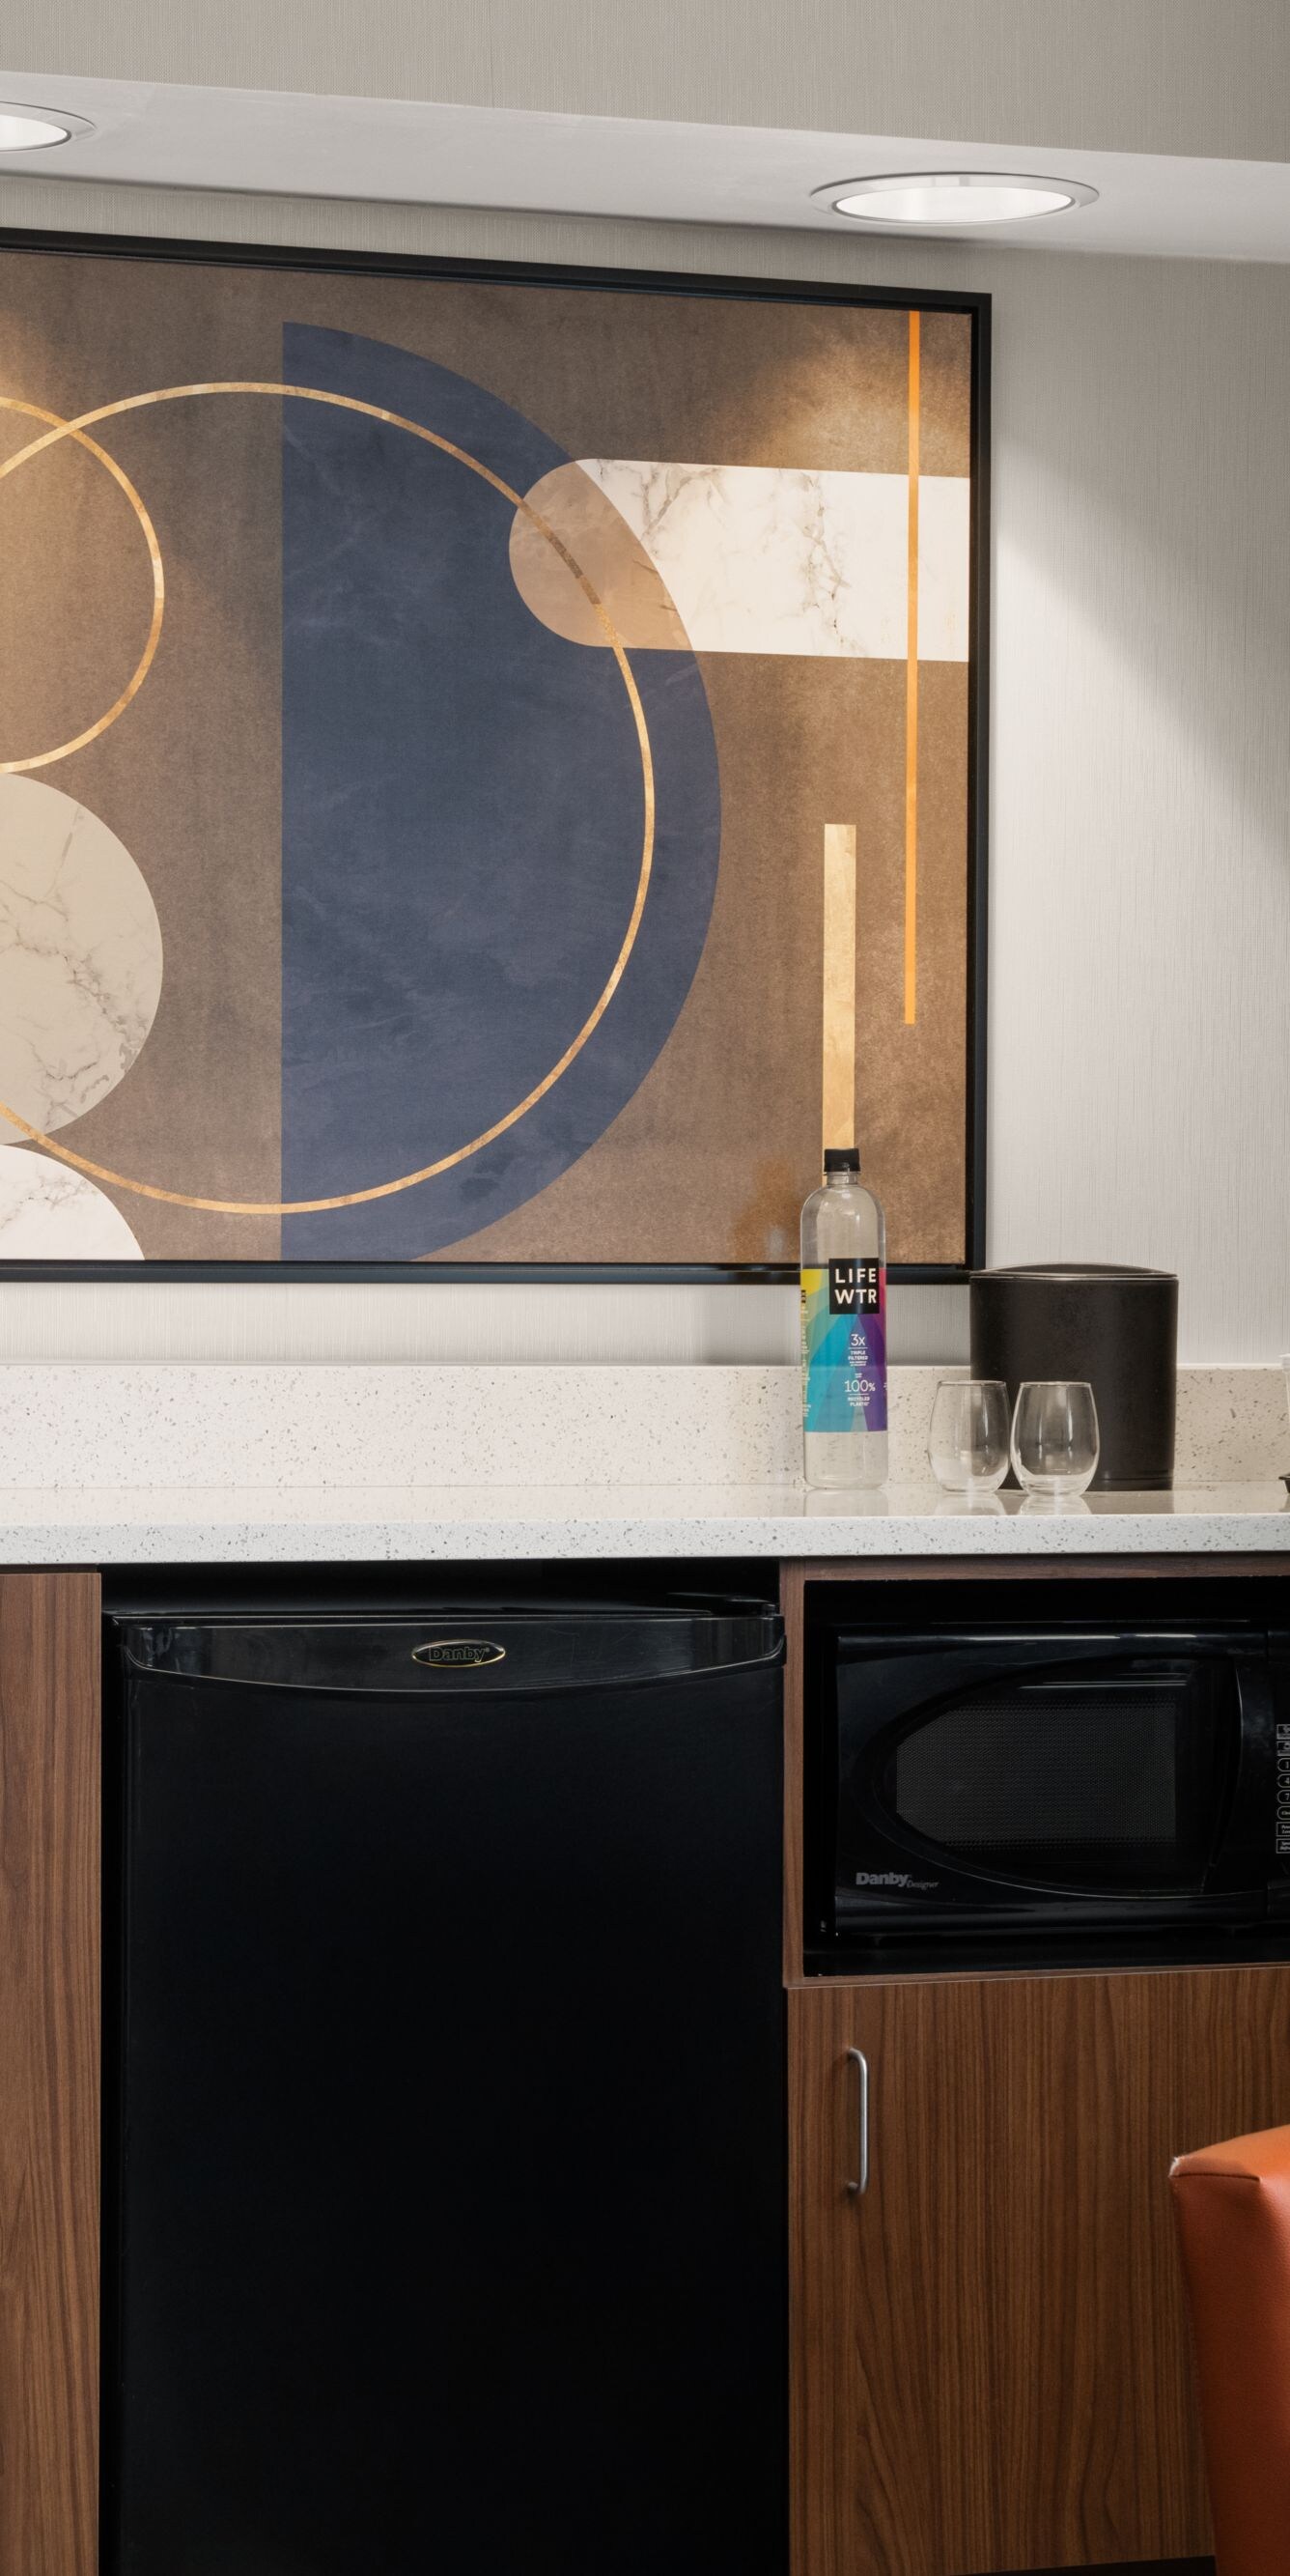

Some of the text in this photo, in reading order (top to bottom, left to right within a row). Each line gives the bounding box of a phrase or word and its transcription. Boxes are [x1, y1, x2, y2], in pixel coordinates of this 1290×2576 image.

[834, 1267, 877, 1284] LIFE
[834, 1288, 878, 1305] WTR
[851, 1333, 866, 1346] 3x
[844, 1379, 876, 1393] 100%
[429, 1646, 486, 1663] Danby
[855, 1872, 909, 1887] Danby
